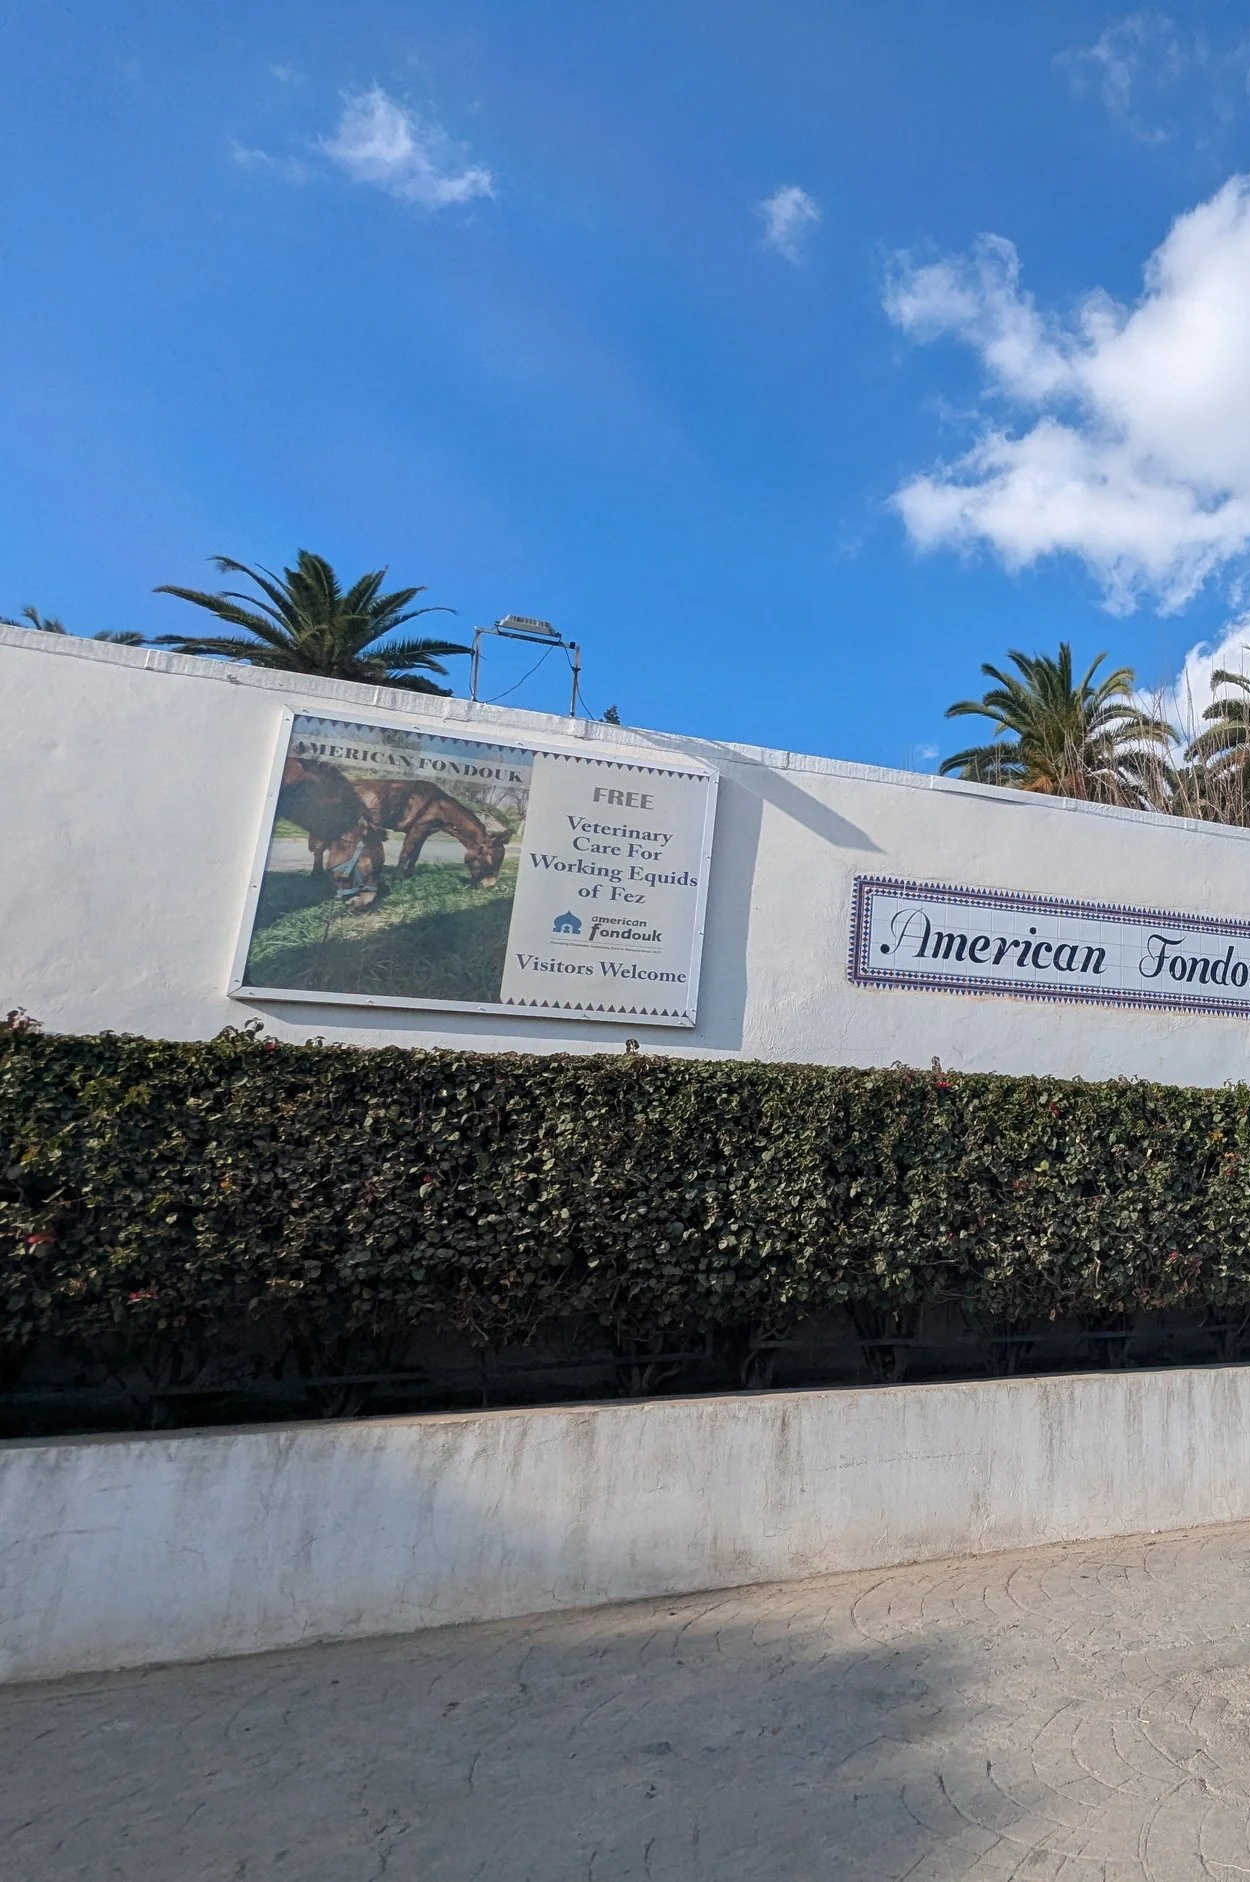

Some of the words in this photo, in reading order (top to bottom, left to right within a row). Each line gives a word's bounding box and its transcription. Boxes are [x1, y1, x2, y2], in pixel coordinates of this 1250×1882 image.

[294, 740, 415, 770] AMERICAN
[418, 757, 524, 784] FONDOUK
[592, 787, 655, 811] FREE
[566, 815, 674, 847] Veterinary
[572, 836, 622, 856] Care
[626, 842, 663, 861] For
[529, 852, 624, 883] Working
[627, 865, 699, 888] Equids
[577, 884, 604, 899] of
[609, 885, 648, 905] Fez
[588, 923, 663, 943] fondouk
[590, 915, 648, 928] american
[879, 906, 1108, 975] American
[516, 953, 594, 976] Visitors
[599, 961, 688, 984] Welcome
